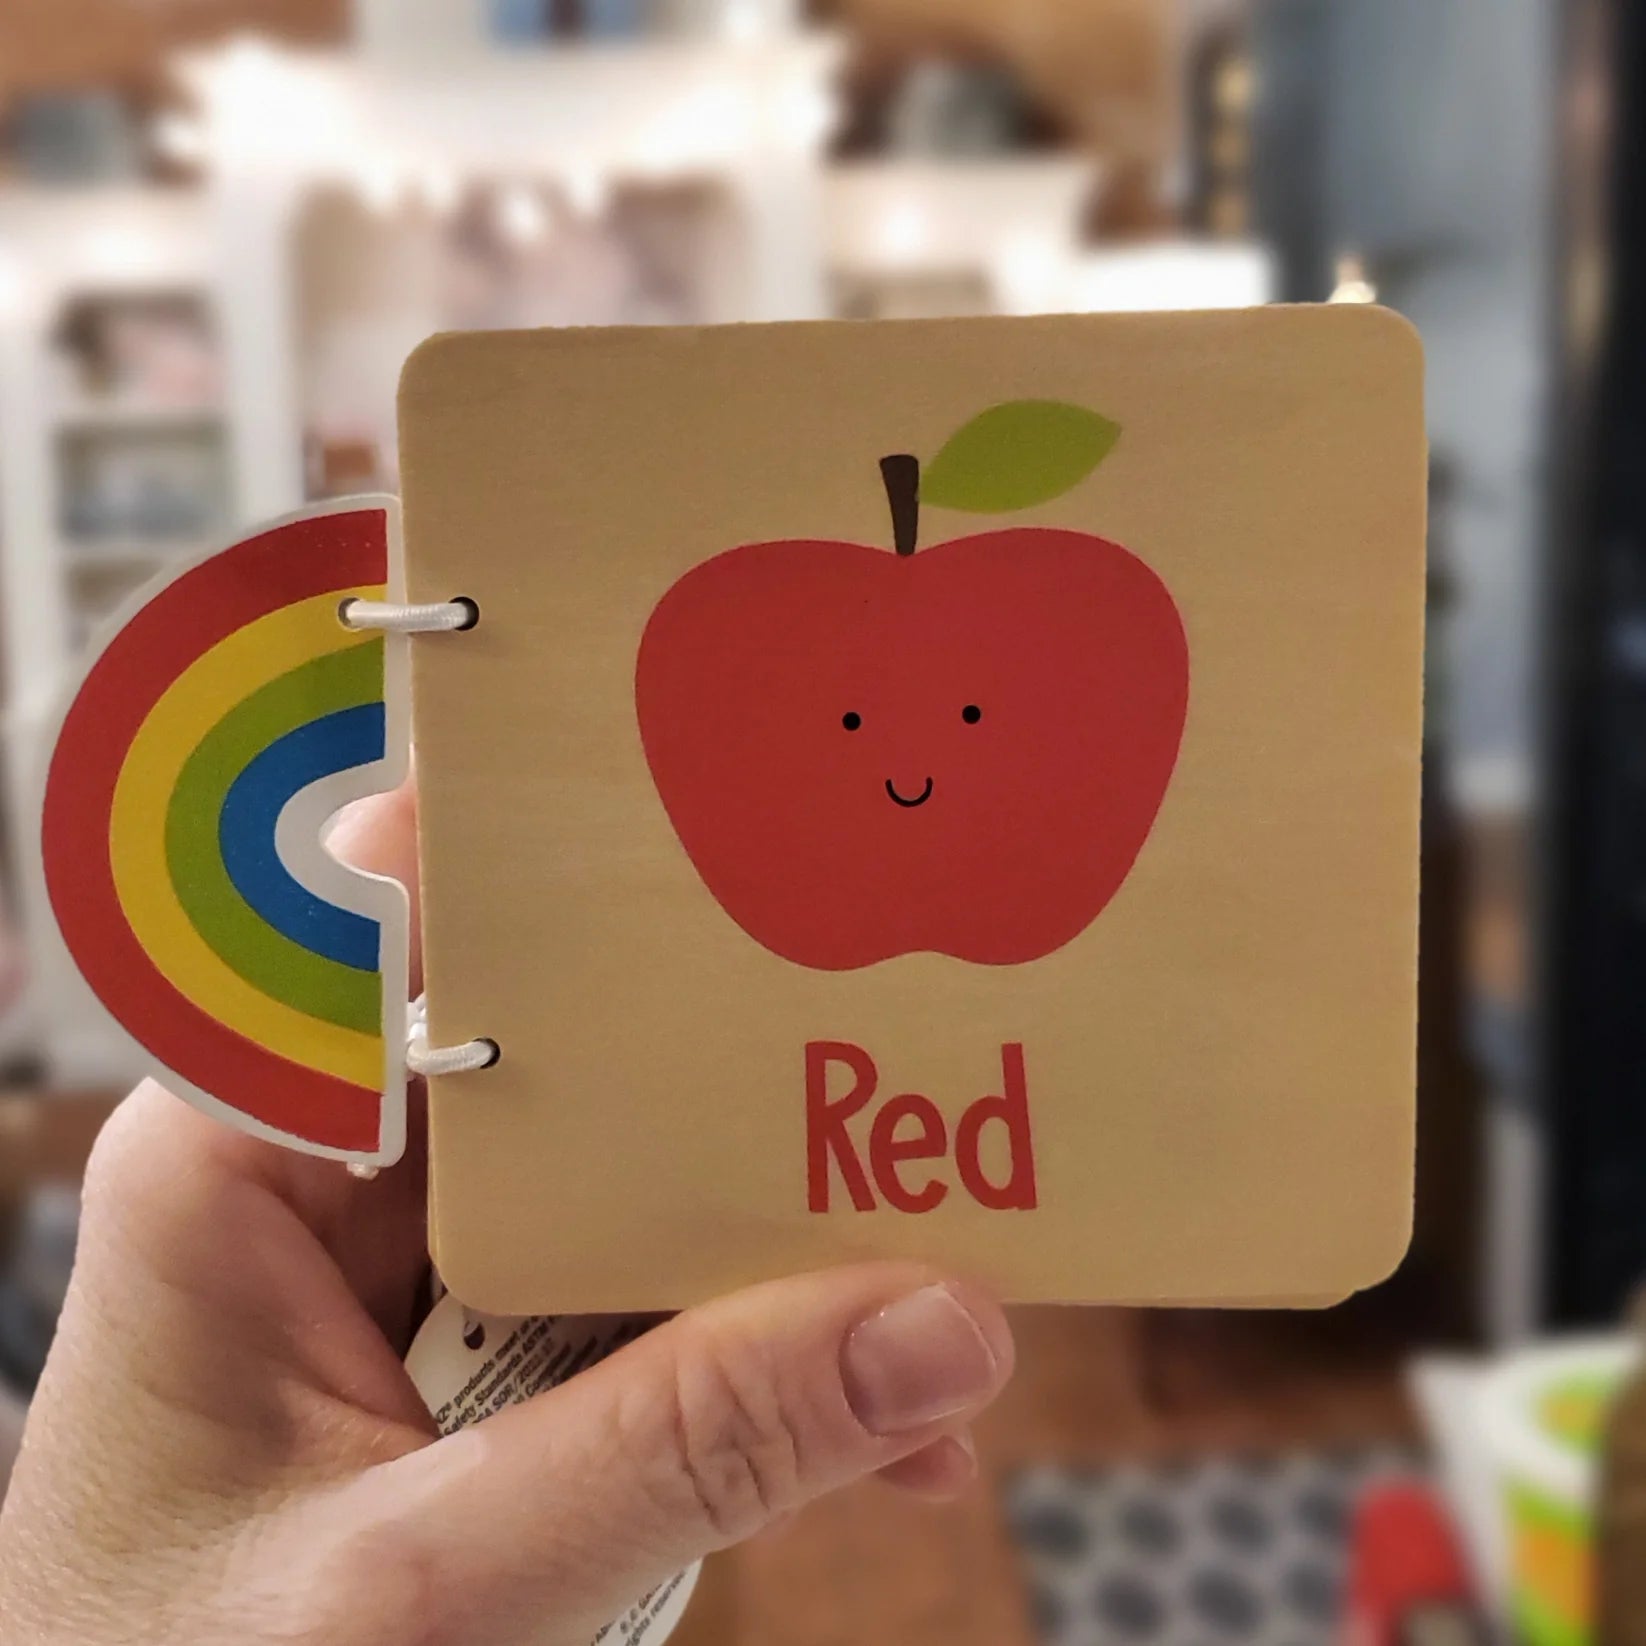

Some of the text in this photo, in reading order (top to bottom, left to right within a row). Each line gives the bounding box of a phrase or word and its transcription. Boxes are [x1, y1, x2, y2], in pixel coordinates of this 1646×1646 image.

[805, 1041, 1037, 1214] Red
[443, 1405, 477, 1436] Safety
[474, 1352, 523, 1406] Standards
[522, 1321, 549, 1355] ASTM
[453, 1359, 496, 1409] products
